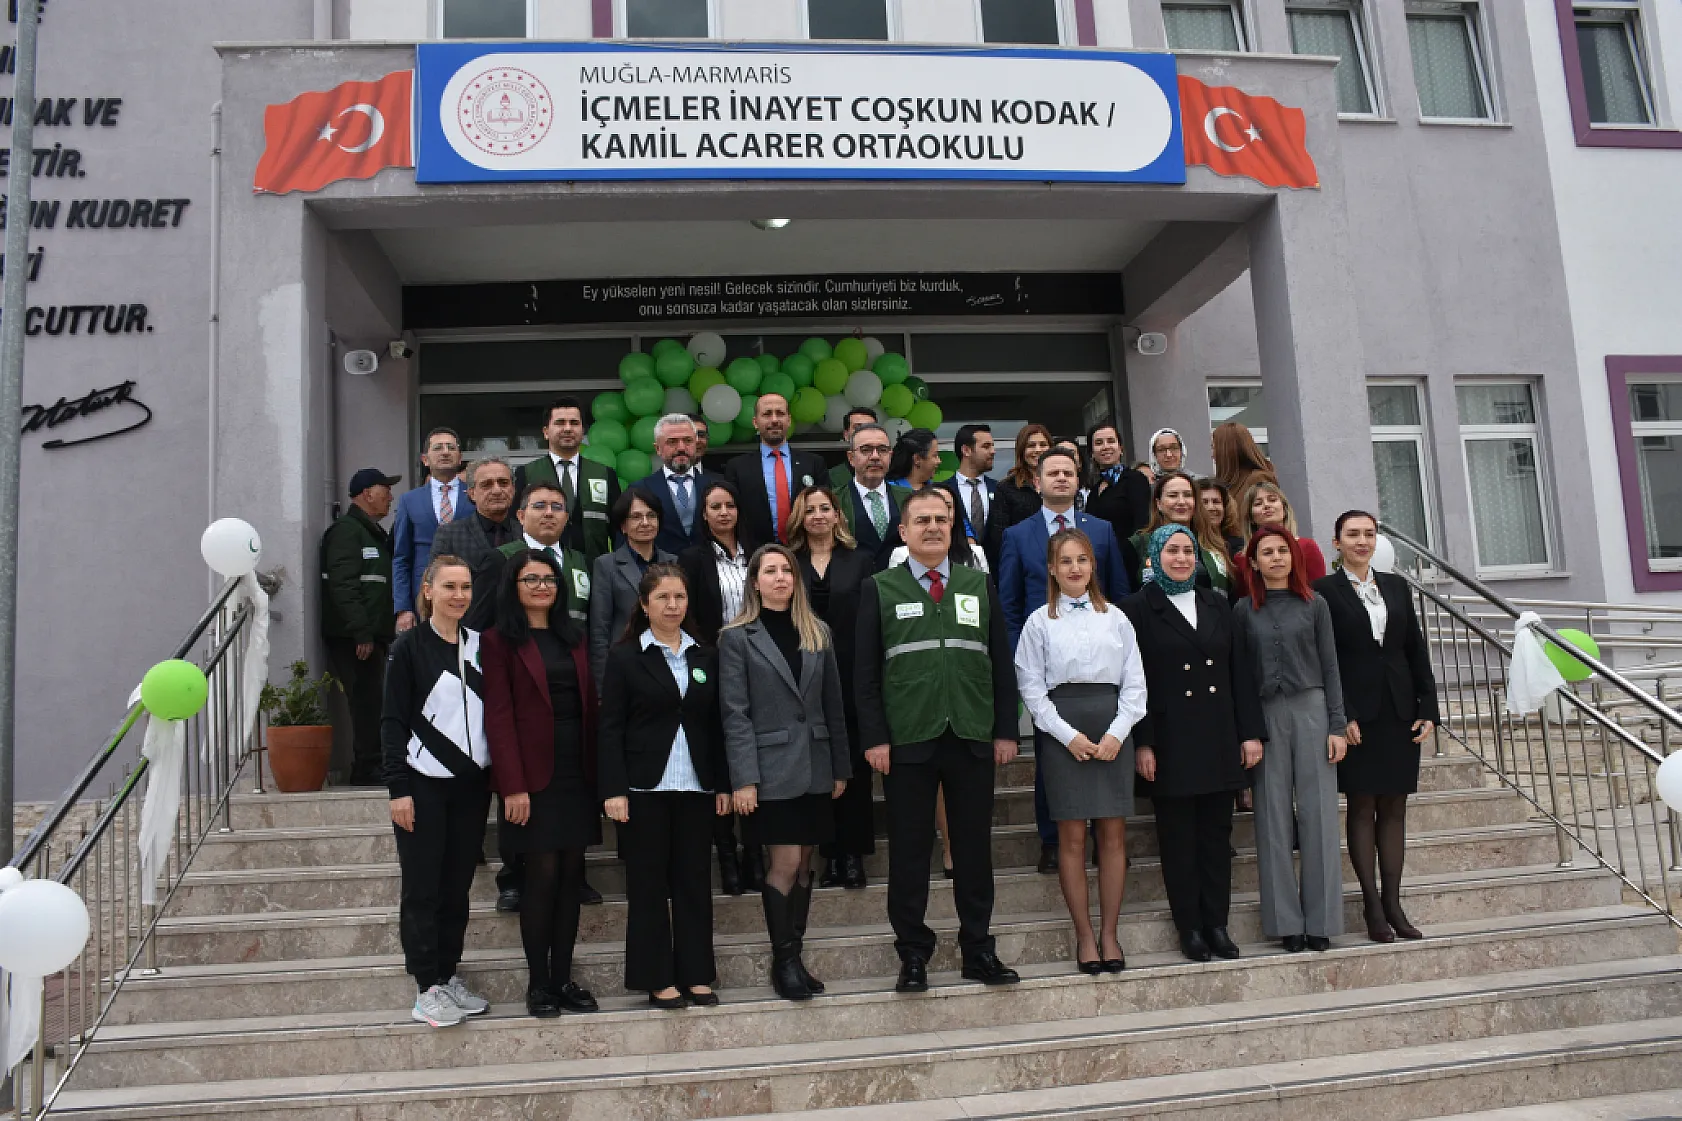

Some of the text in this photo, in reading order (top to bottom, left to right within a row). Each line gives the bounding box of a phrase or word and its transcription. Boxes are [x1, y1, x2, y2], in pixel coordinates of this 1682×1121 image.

[579, 62, 792, 84] MUĞLA-MARMARİS
[84, 97, 121, 126] VE
[581, 89, 1116, 129] İÇMELER İNAYET COŞKUN KODAK /
[581, 126, 1025, 160] KAMİL ACARER ORTAOKULU
[66, 198, 190, 228] KUDRET
[583, 278, 963, 301] Ey yükselen yeni nesil! Gelecek sizindir. Cumhuriyeti biz kurduk,
[25, 303, 154, 336] CUTTUR.
[638, 297, 913, 316] onu sonsuza kadar yaşatacak olan sizlersiniz.
